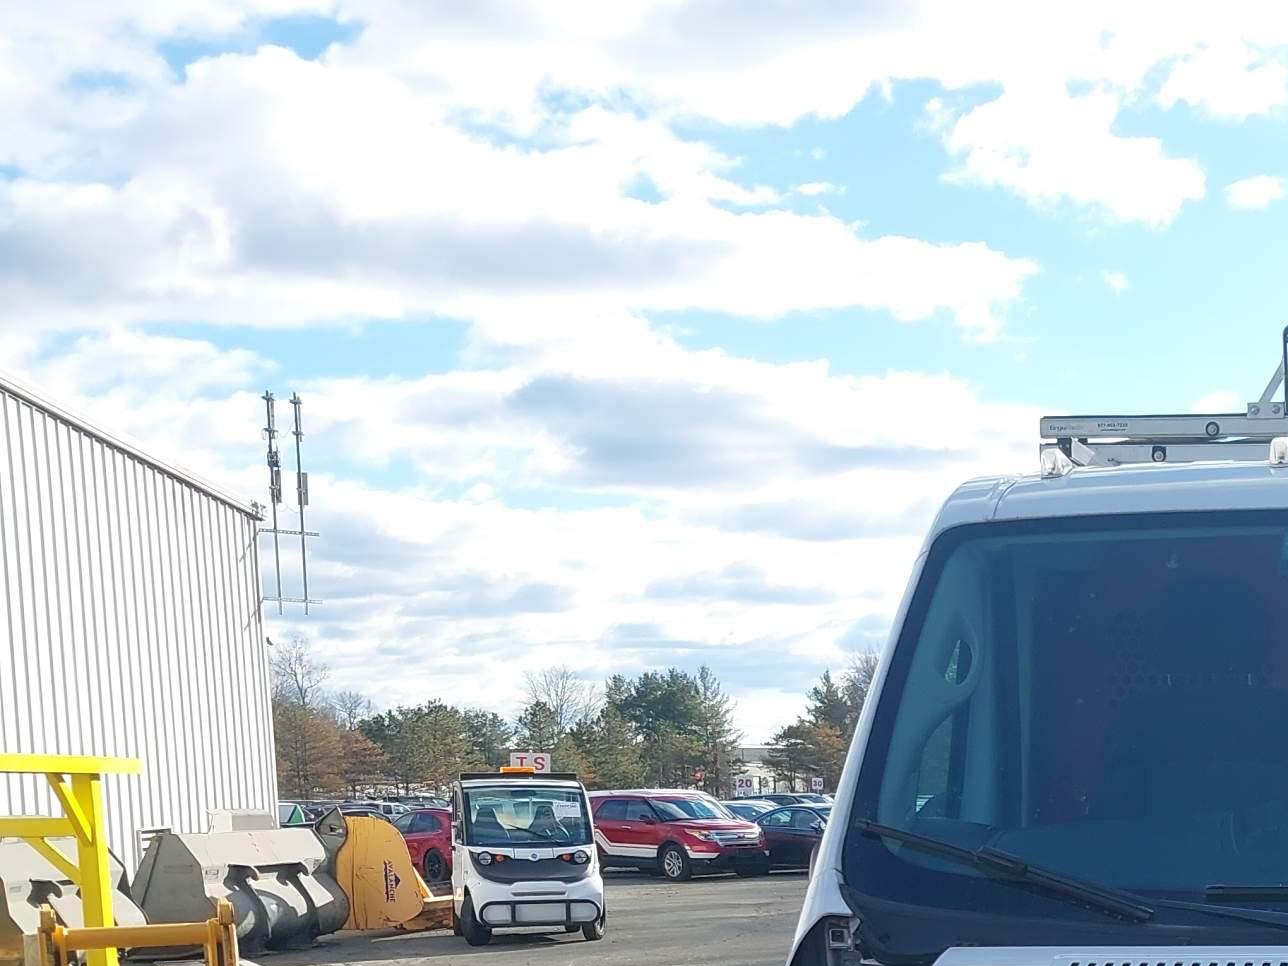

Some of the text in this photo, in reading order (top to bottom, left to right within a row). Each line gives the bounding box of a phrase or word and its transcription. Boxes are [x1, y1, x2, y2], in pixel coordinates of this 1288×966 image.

[738, 778, 753, 789] 20
[812, 779, 823, 788] 30
[388, 859, 396, 903] AVALANCHE
